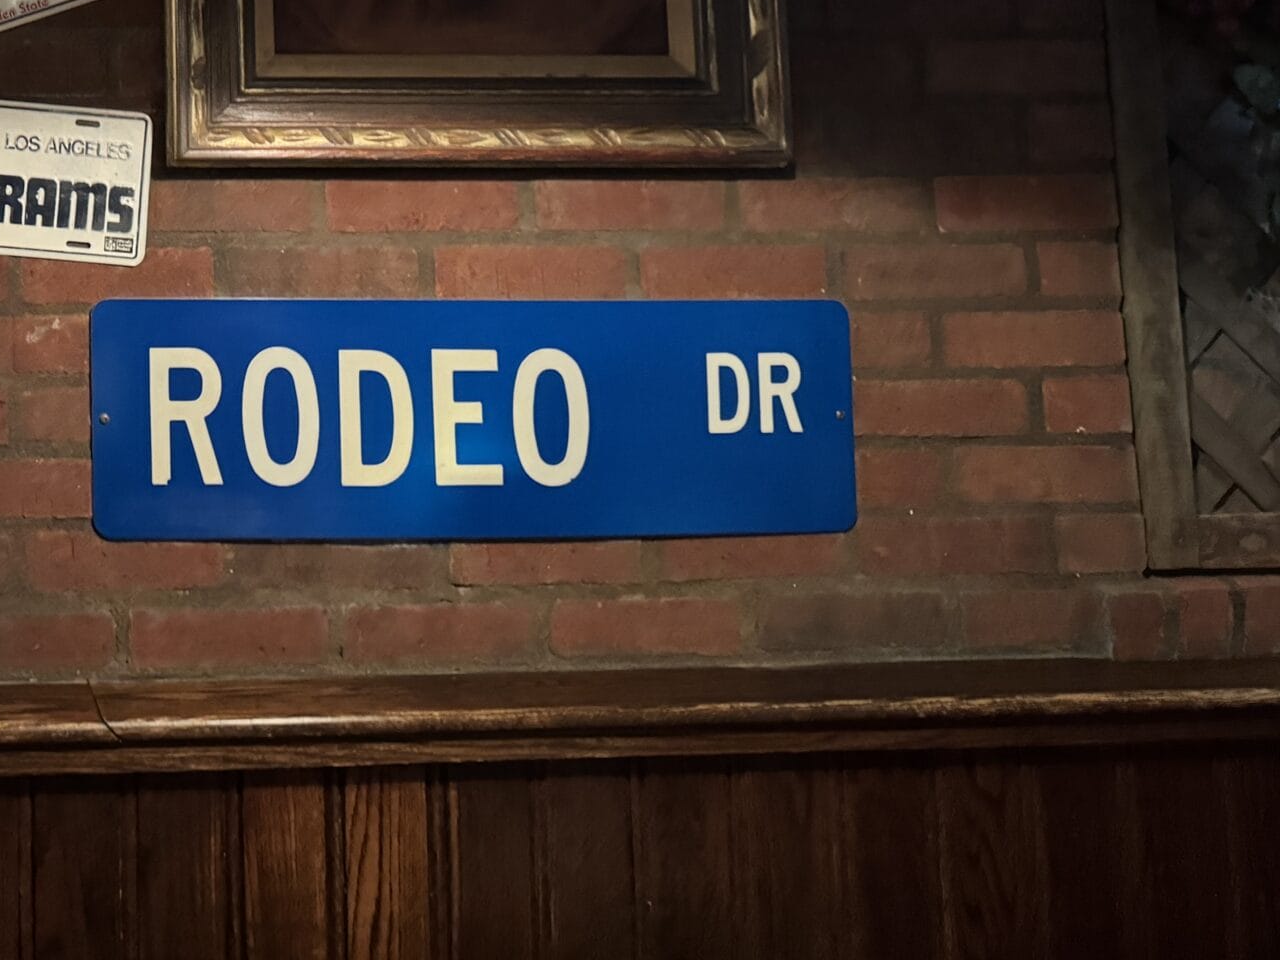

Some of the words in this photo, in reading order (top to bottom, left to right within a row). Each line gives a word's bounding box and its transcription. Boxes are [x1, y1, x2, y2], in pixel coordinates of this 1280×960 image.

[4, 132, 41, 153] LOS
[45, 134, 133, 161] ANGELES
[148, 346, 590, 487] RODEO
[705, 352, 804, 434] DR
